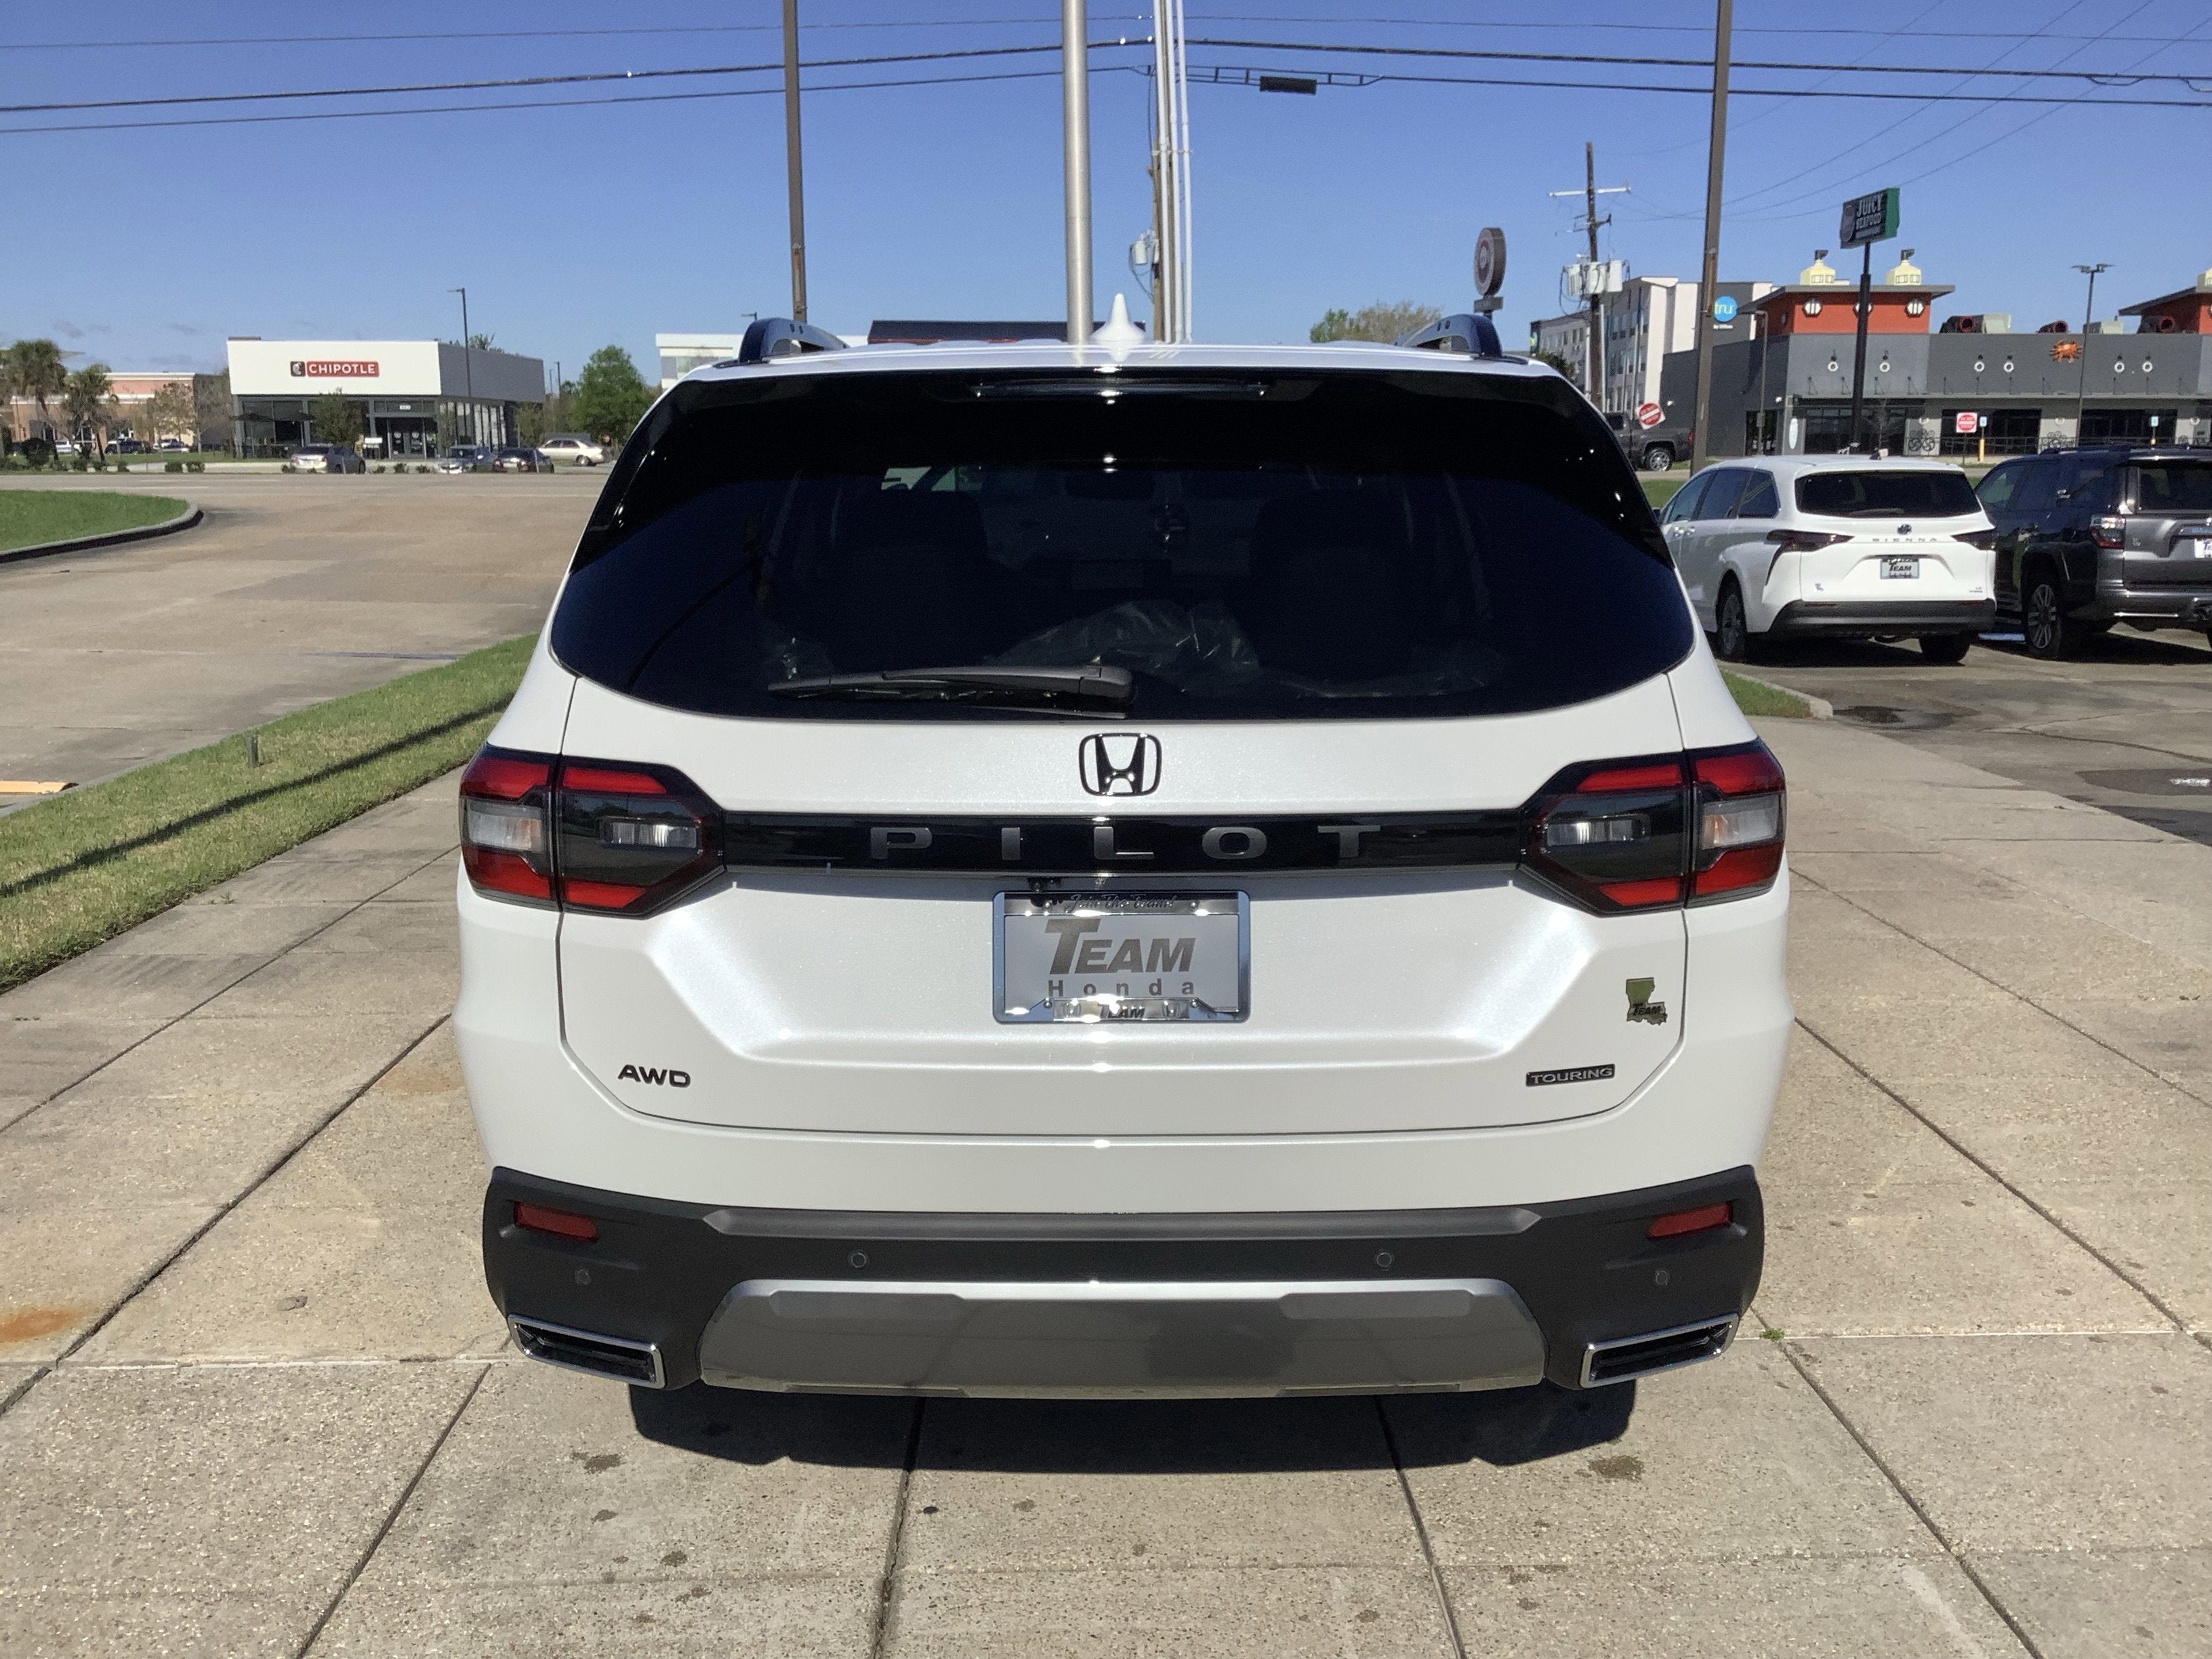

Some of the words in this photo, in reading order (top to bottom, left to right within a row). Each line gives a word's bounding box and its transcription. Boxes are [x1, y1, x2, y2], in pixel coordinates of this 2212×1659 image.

[1857, 193, 1883, 217] JUICY
[308, 363, 375, 374] CHIPOTLE
[1889, 560, 1912, 572] TEAM
[870, 825, 1382, 861] PILOT
[1065, 893, 1101, 913] Join
[1044, 918, 1196, 975] TEAM
[1048, 978, 1195, 997] Honda
[1632, 1003, 1662, 1017] TEAM
[617, 1064, 691, 1088] AWD
[1531, 1067, 1613, 1085] TOURING
